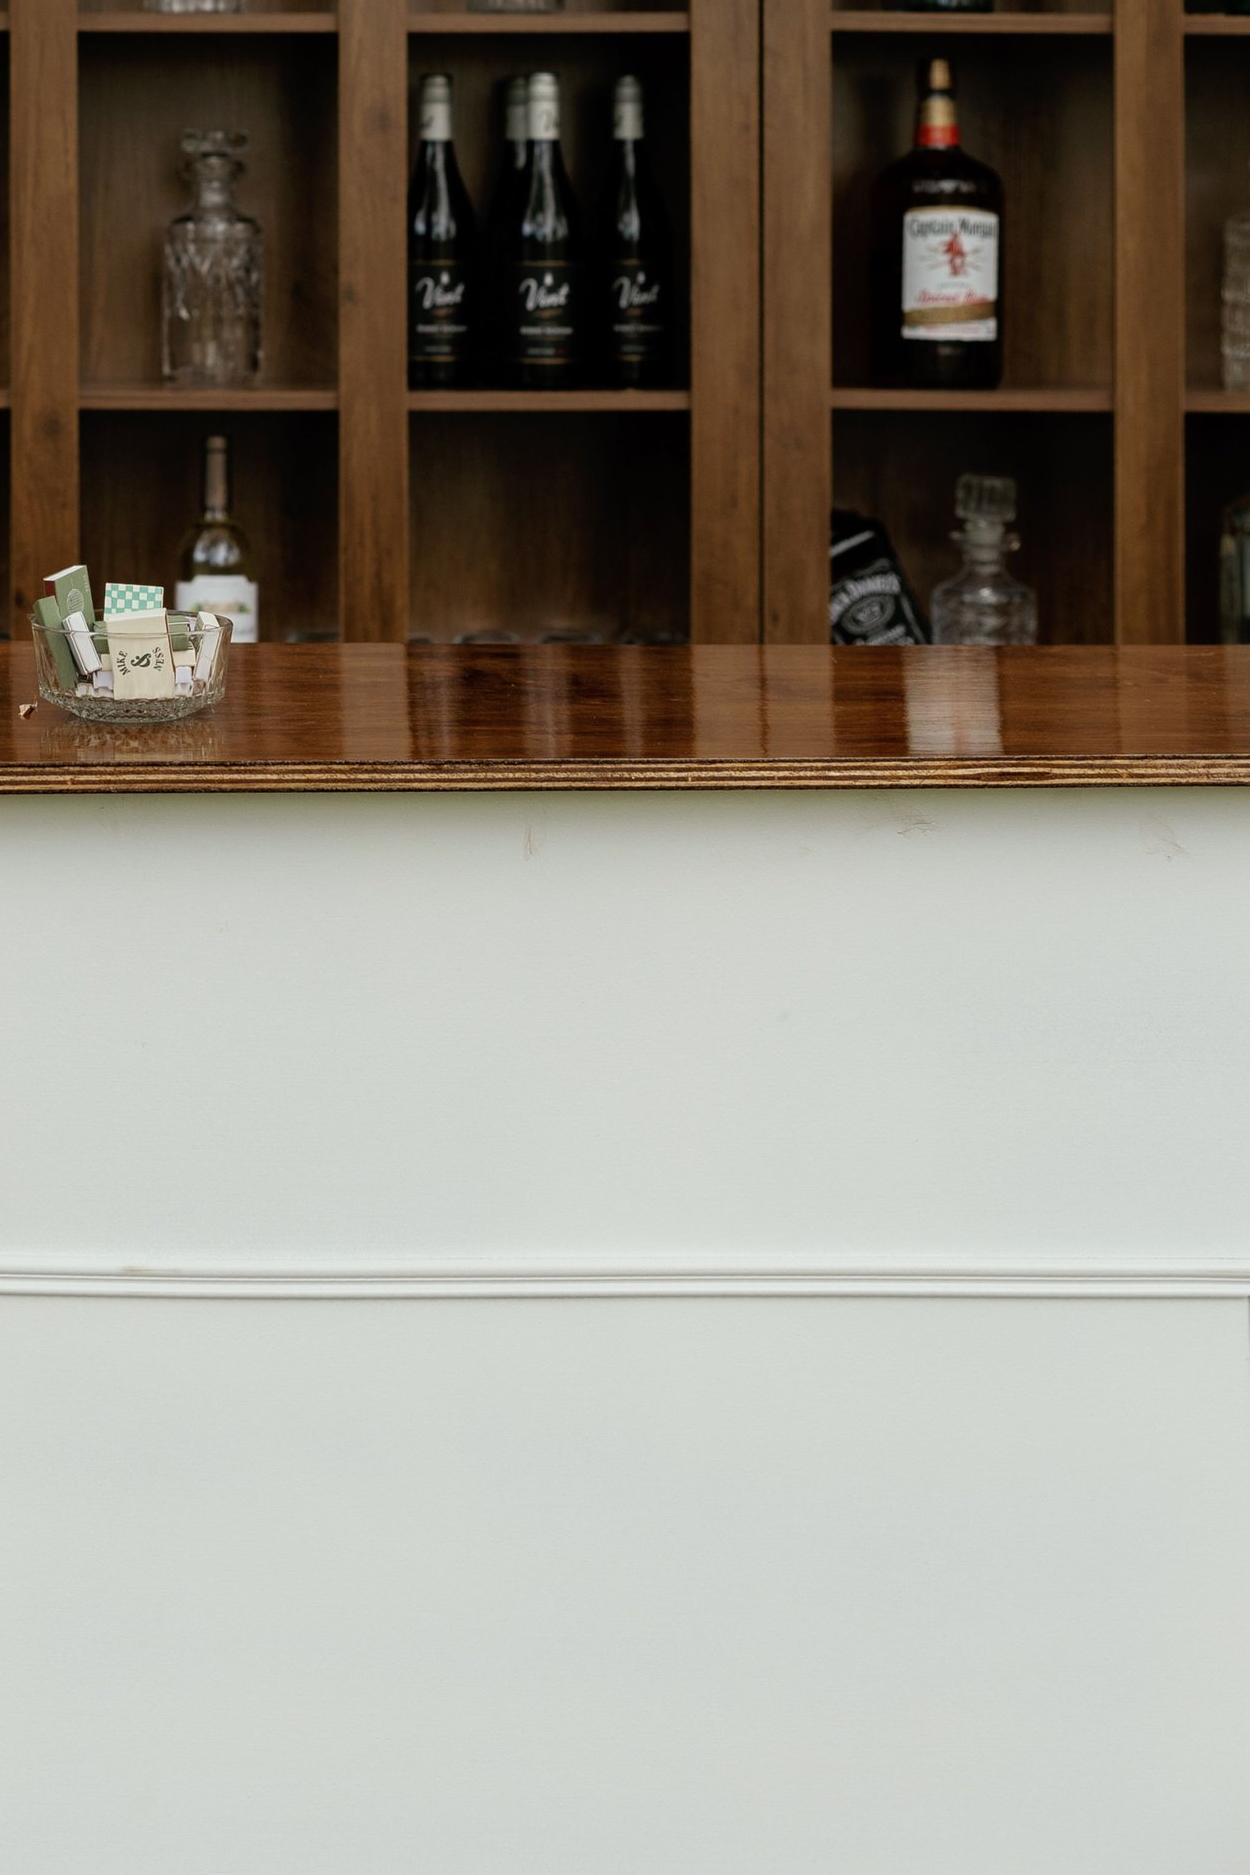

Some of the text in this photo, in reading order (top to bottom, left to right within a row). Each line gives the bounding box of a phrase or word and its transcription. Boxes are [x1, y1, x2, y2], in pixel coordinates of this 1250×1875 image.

[116, 646, 165, 676] MIKE & NESS
